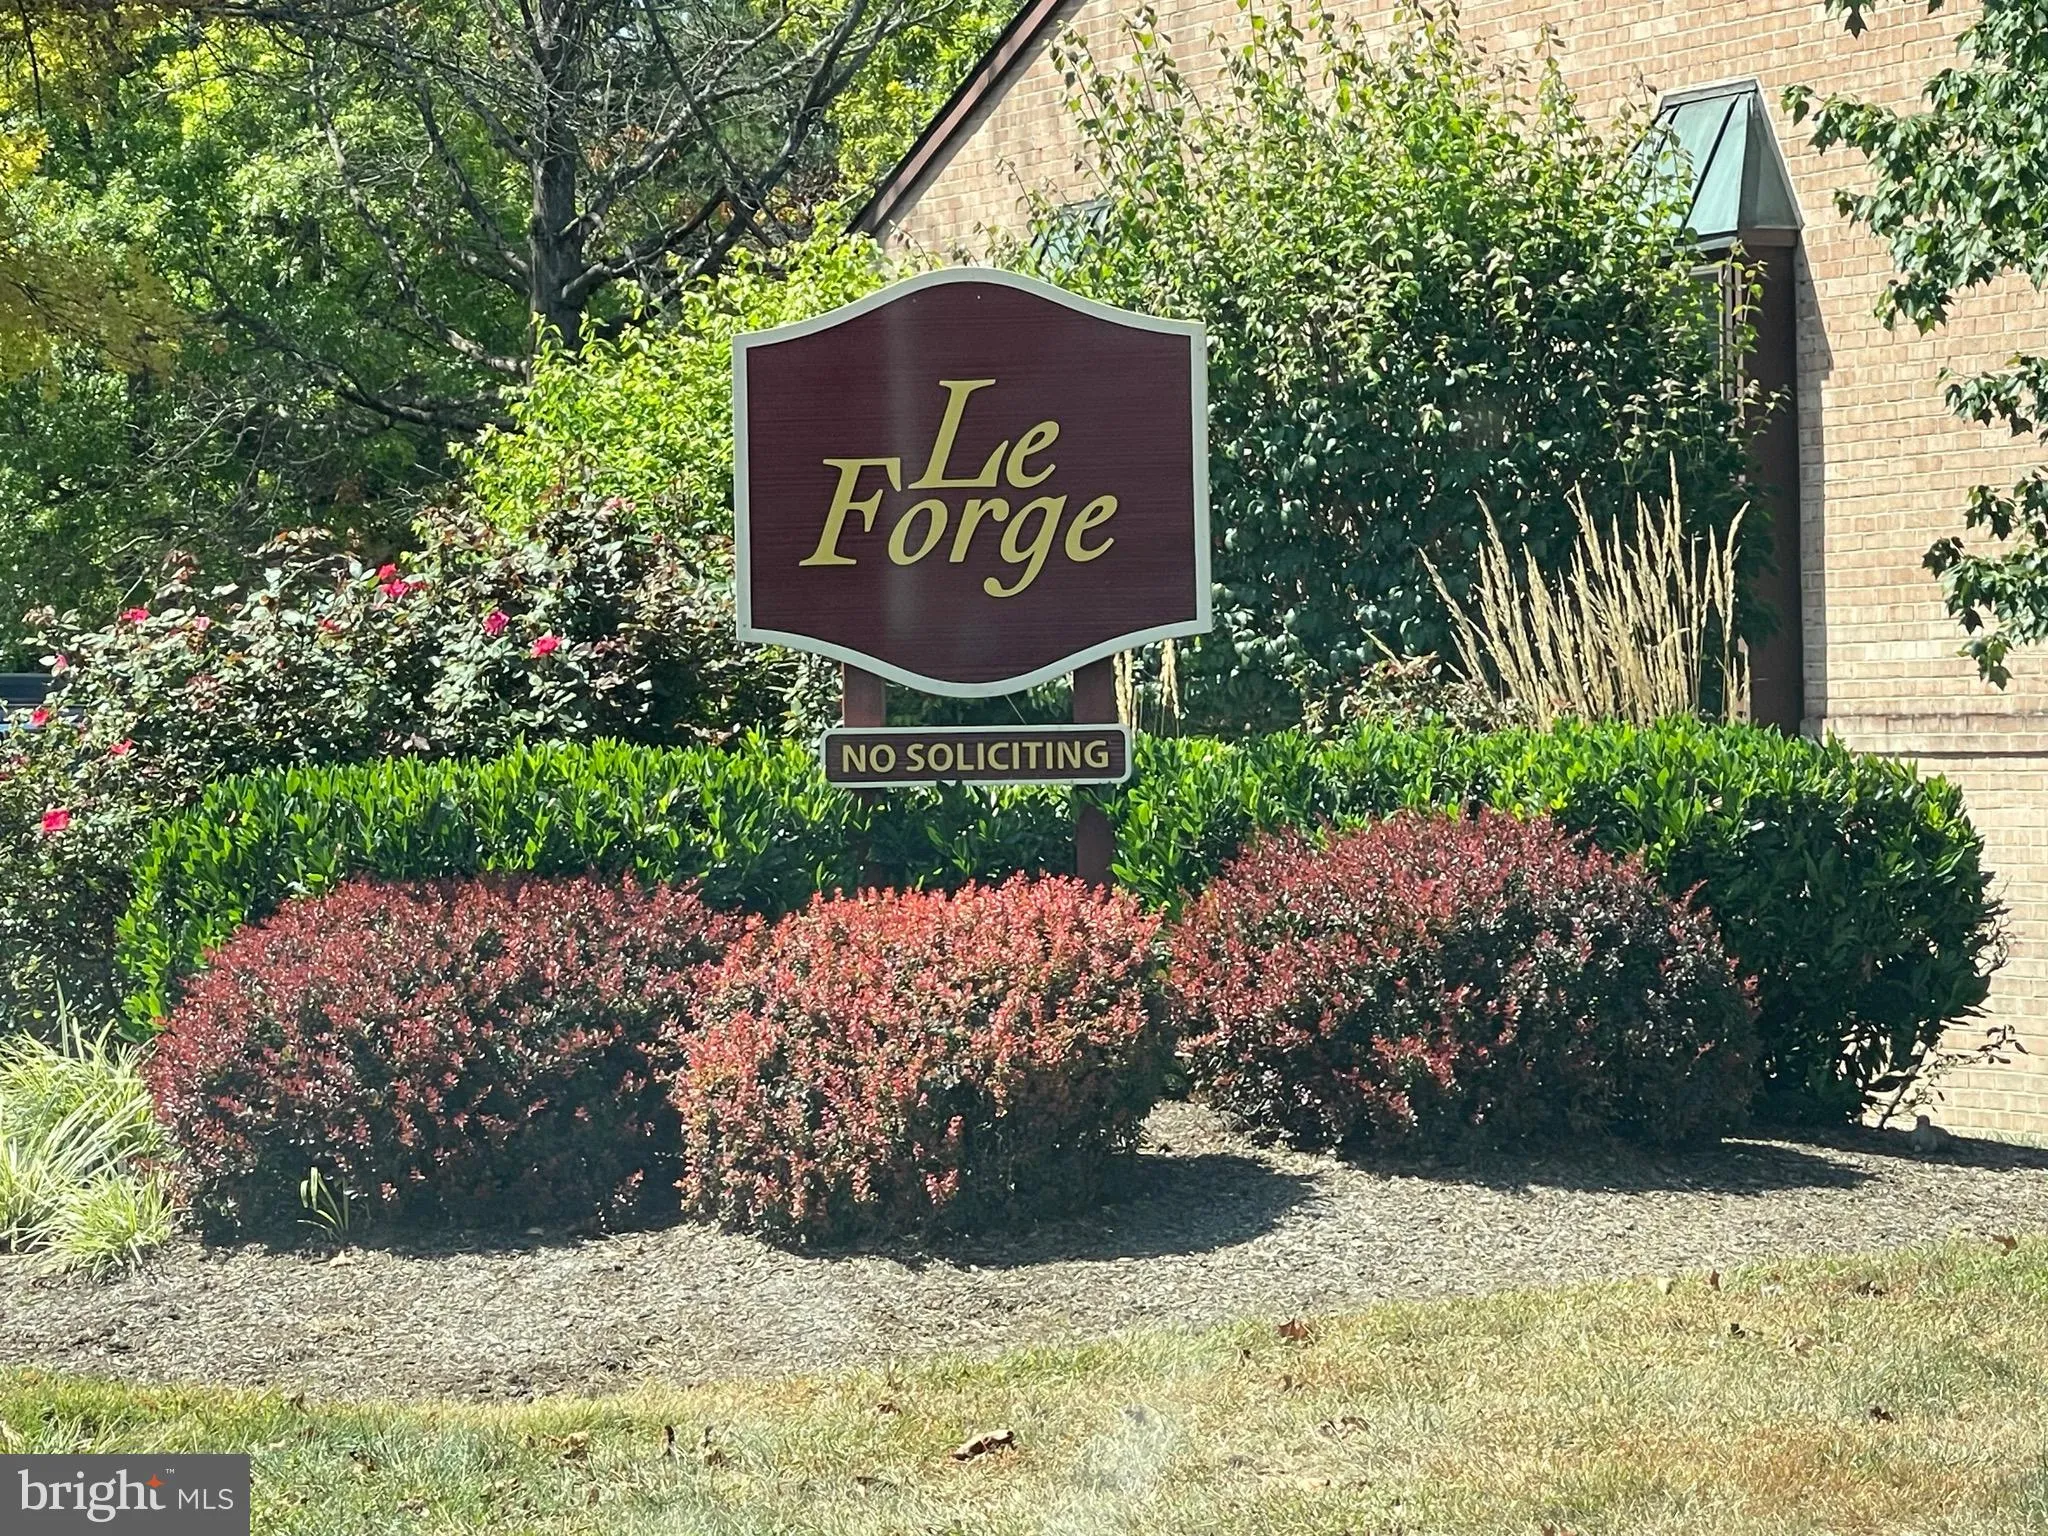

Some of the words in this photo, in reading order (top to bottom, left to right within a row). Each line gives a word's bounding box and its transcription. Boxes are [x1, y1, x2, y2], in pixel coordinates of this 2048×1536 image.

[908, 378, 1060, 489] Le
[799, 457, 1119, 598] Forge
[841, 743, 897, 774] NO
[906, 739, 1110, 773] SOLICITING
